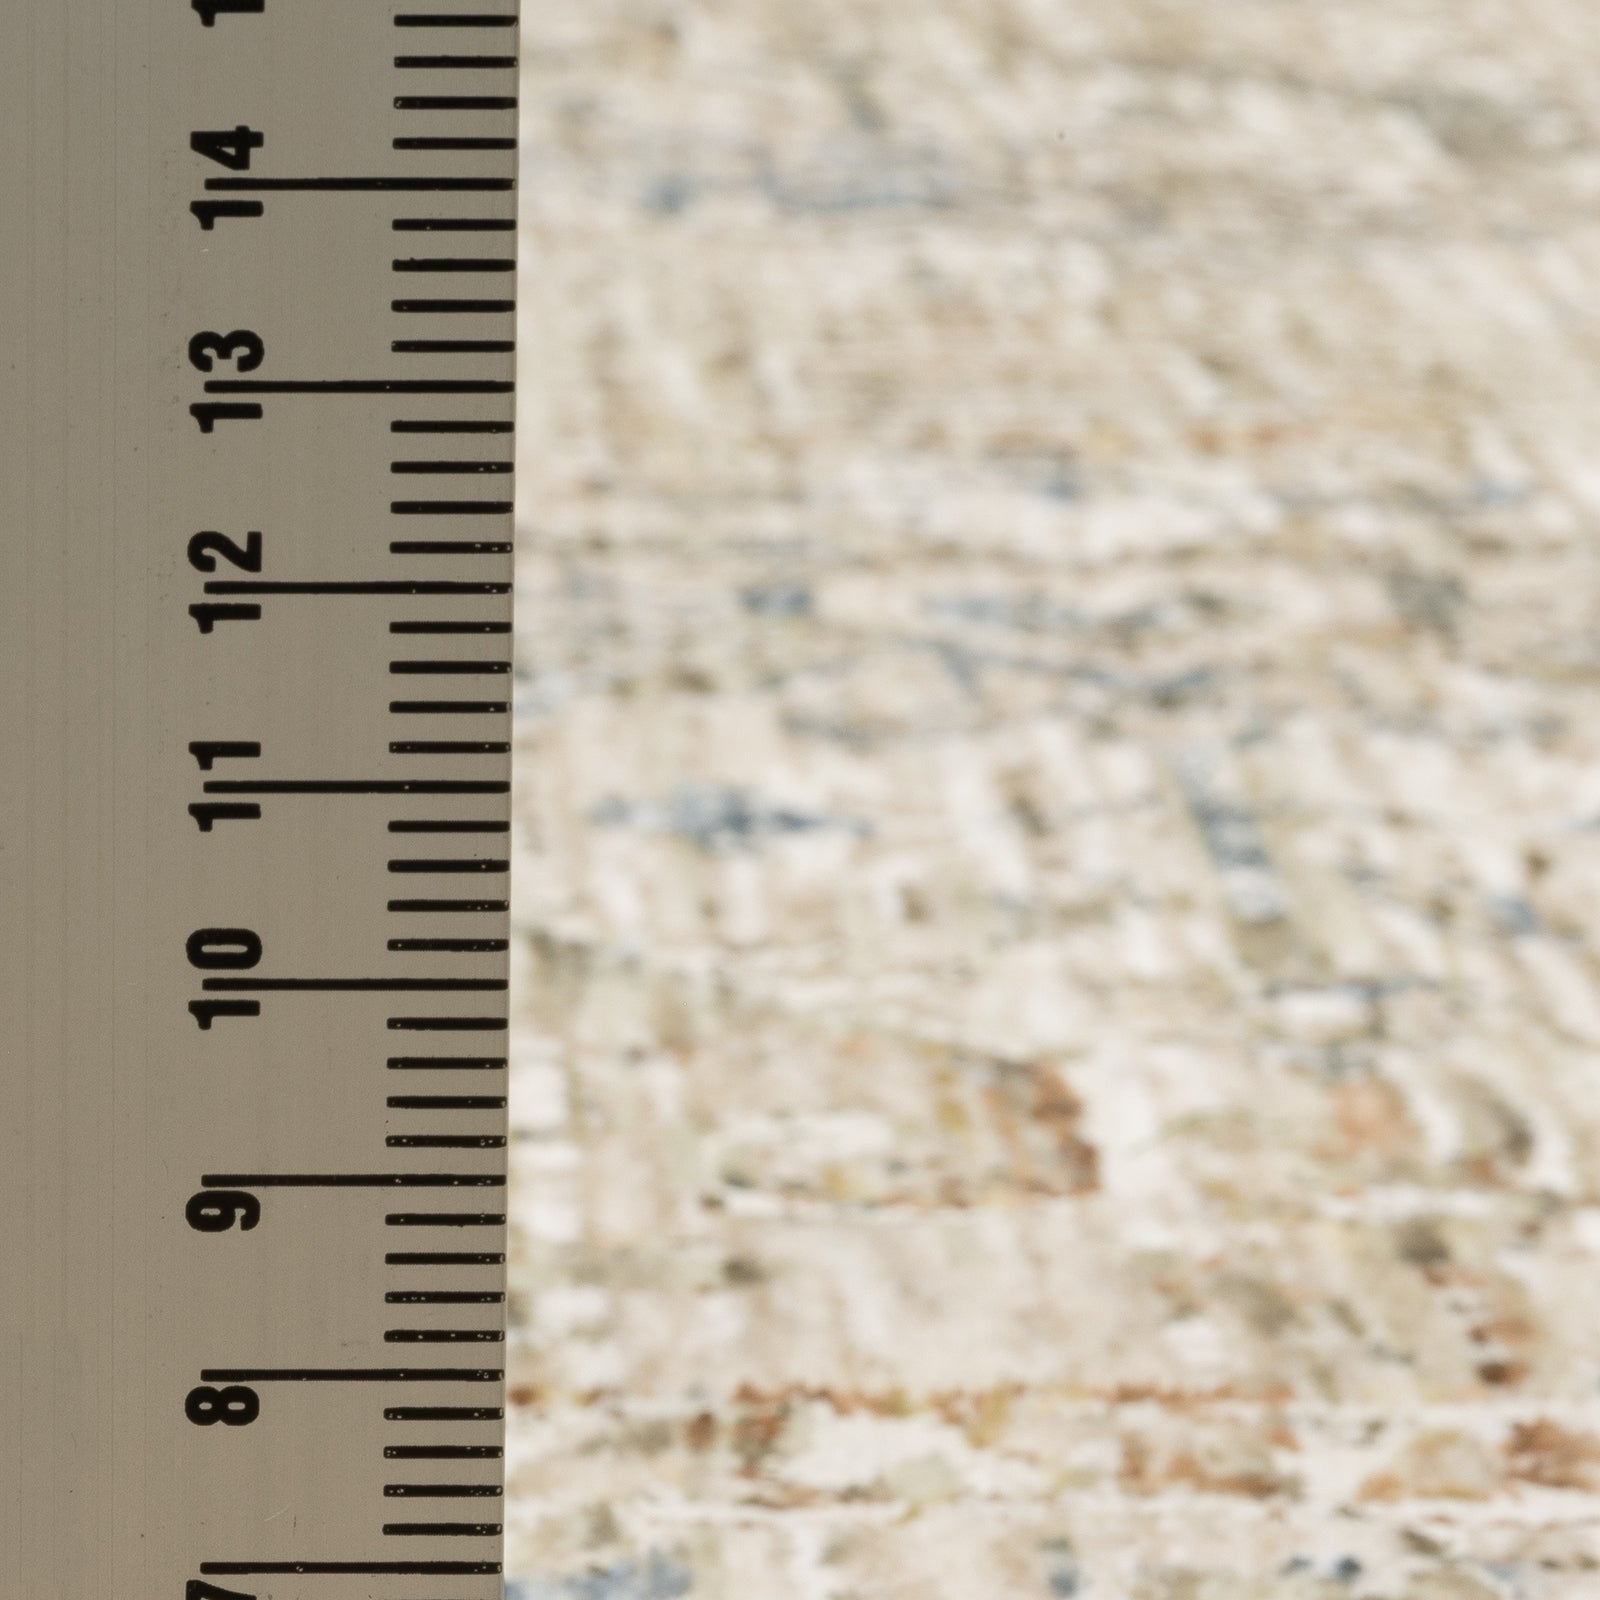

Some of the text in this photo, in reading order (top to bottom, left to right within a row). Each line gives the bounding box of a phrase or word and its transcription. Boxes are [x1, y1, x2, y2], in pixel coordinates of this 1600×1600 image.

[189, 126, 264, 231] 14
[188, 330, 265, 434] 13
[187, 530, 263, 635] 12
[187, 742, 262, 833] 11
[186, 928, 262, 1031] 10
[185, 1190, 260, 1233] 9
[185, 1386, 259, 1427] 8
